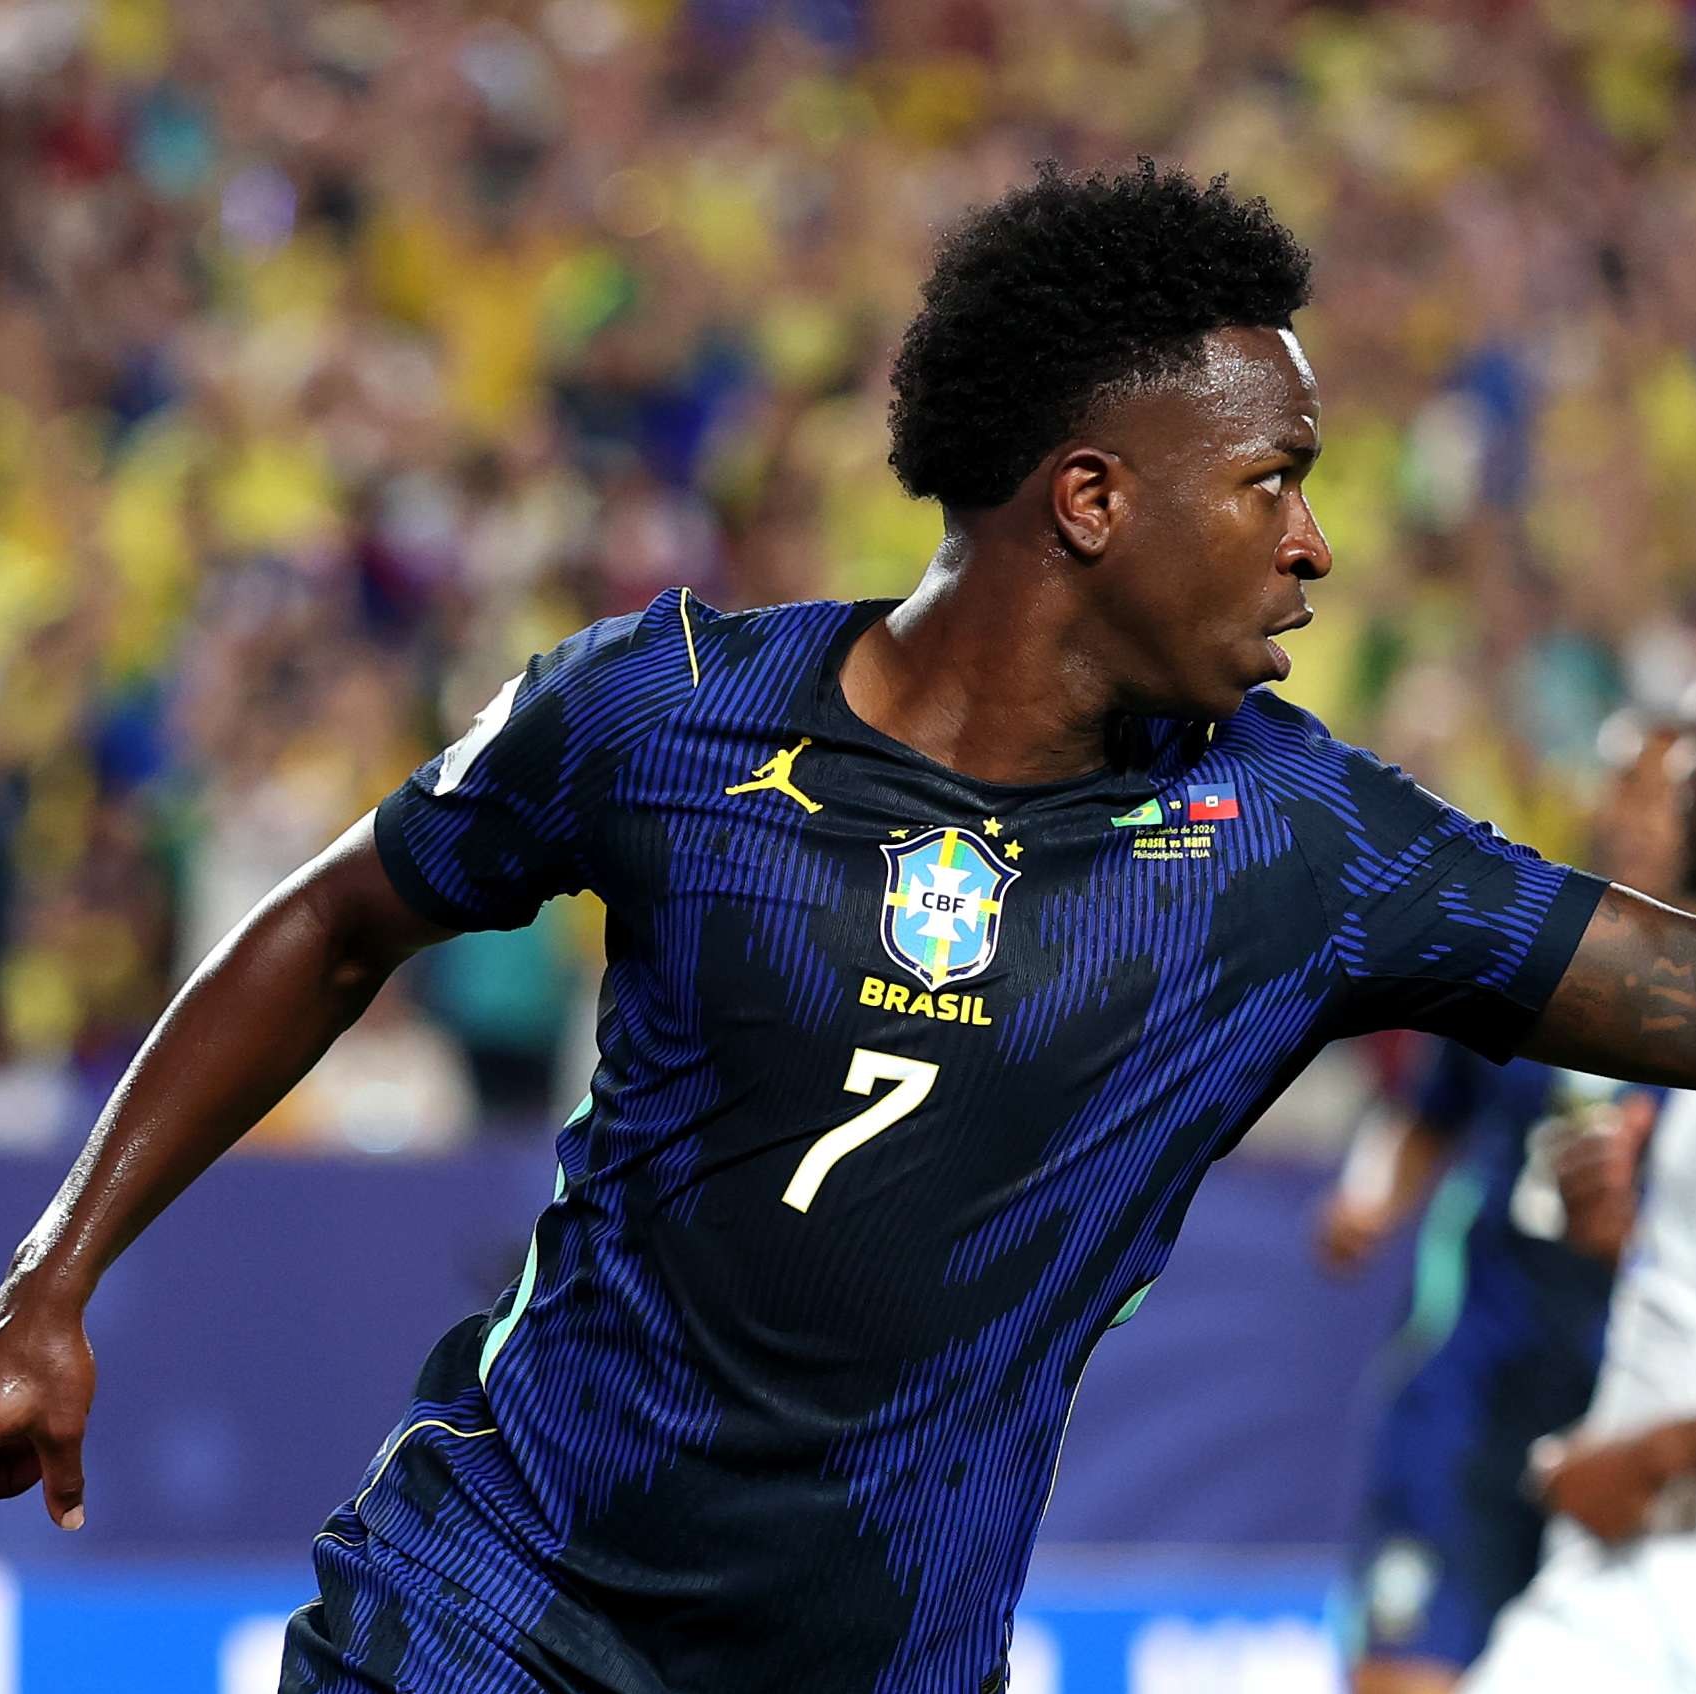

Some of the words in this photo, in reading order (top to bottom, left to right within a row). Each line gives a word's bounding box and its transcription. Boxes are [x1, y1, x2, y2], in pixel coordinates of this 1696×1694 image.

[1192, 824, 1216, 834] 2026
[1190, 849, 1211, 858] EUA
[921, 892, 966, 914] CBF
[859, 976, 993, 1026] BRASIL
[781, 1047, 940, 1213] 7
